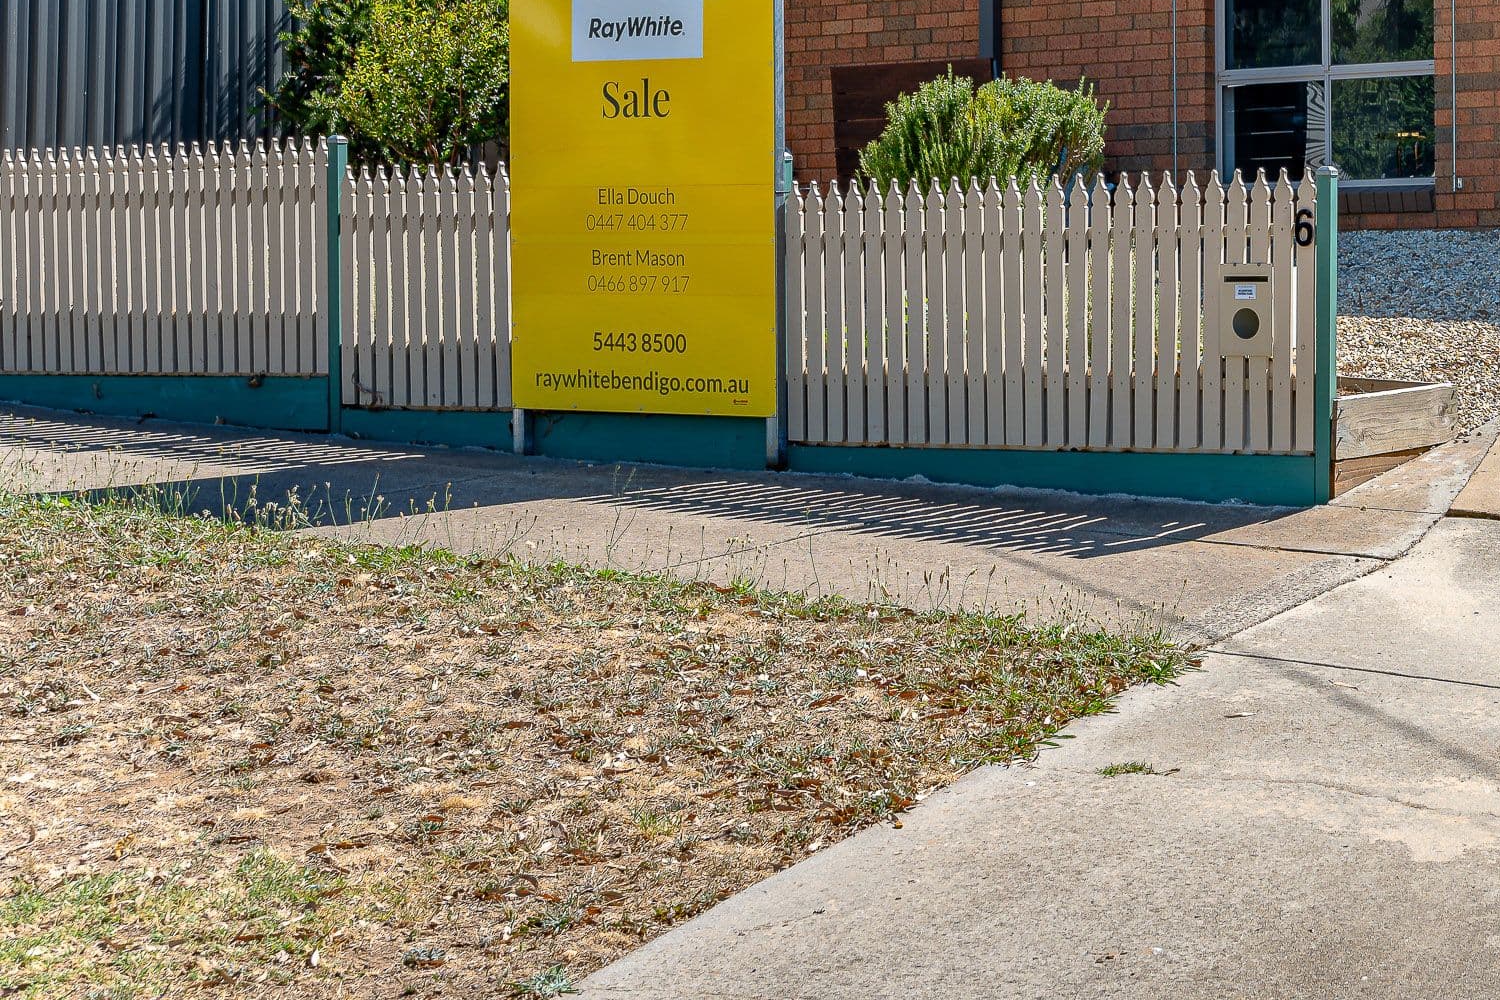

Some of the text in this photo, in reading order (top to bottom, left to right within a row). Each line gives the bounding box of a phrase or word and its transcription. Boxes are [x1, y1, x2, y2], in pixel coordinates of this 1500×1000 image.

[602, 78, 670, 119] Sale
[598, 188, 676, 205] Ella Douch
[586, 214, 689, 231] 0447 404 377
[1295, 209, 1313, 246] 6
[592, 249, 685, 266] Brent Mason
[587, 276, 690, 293] 0466 897 917
[593, 332, 687, 354] 5443 8500
[535, 369, 749, 396] raywhitebendigo.com.au
